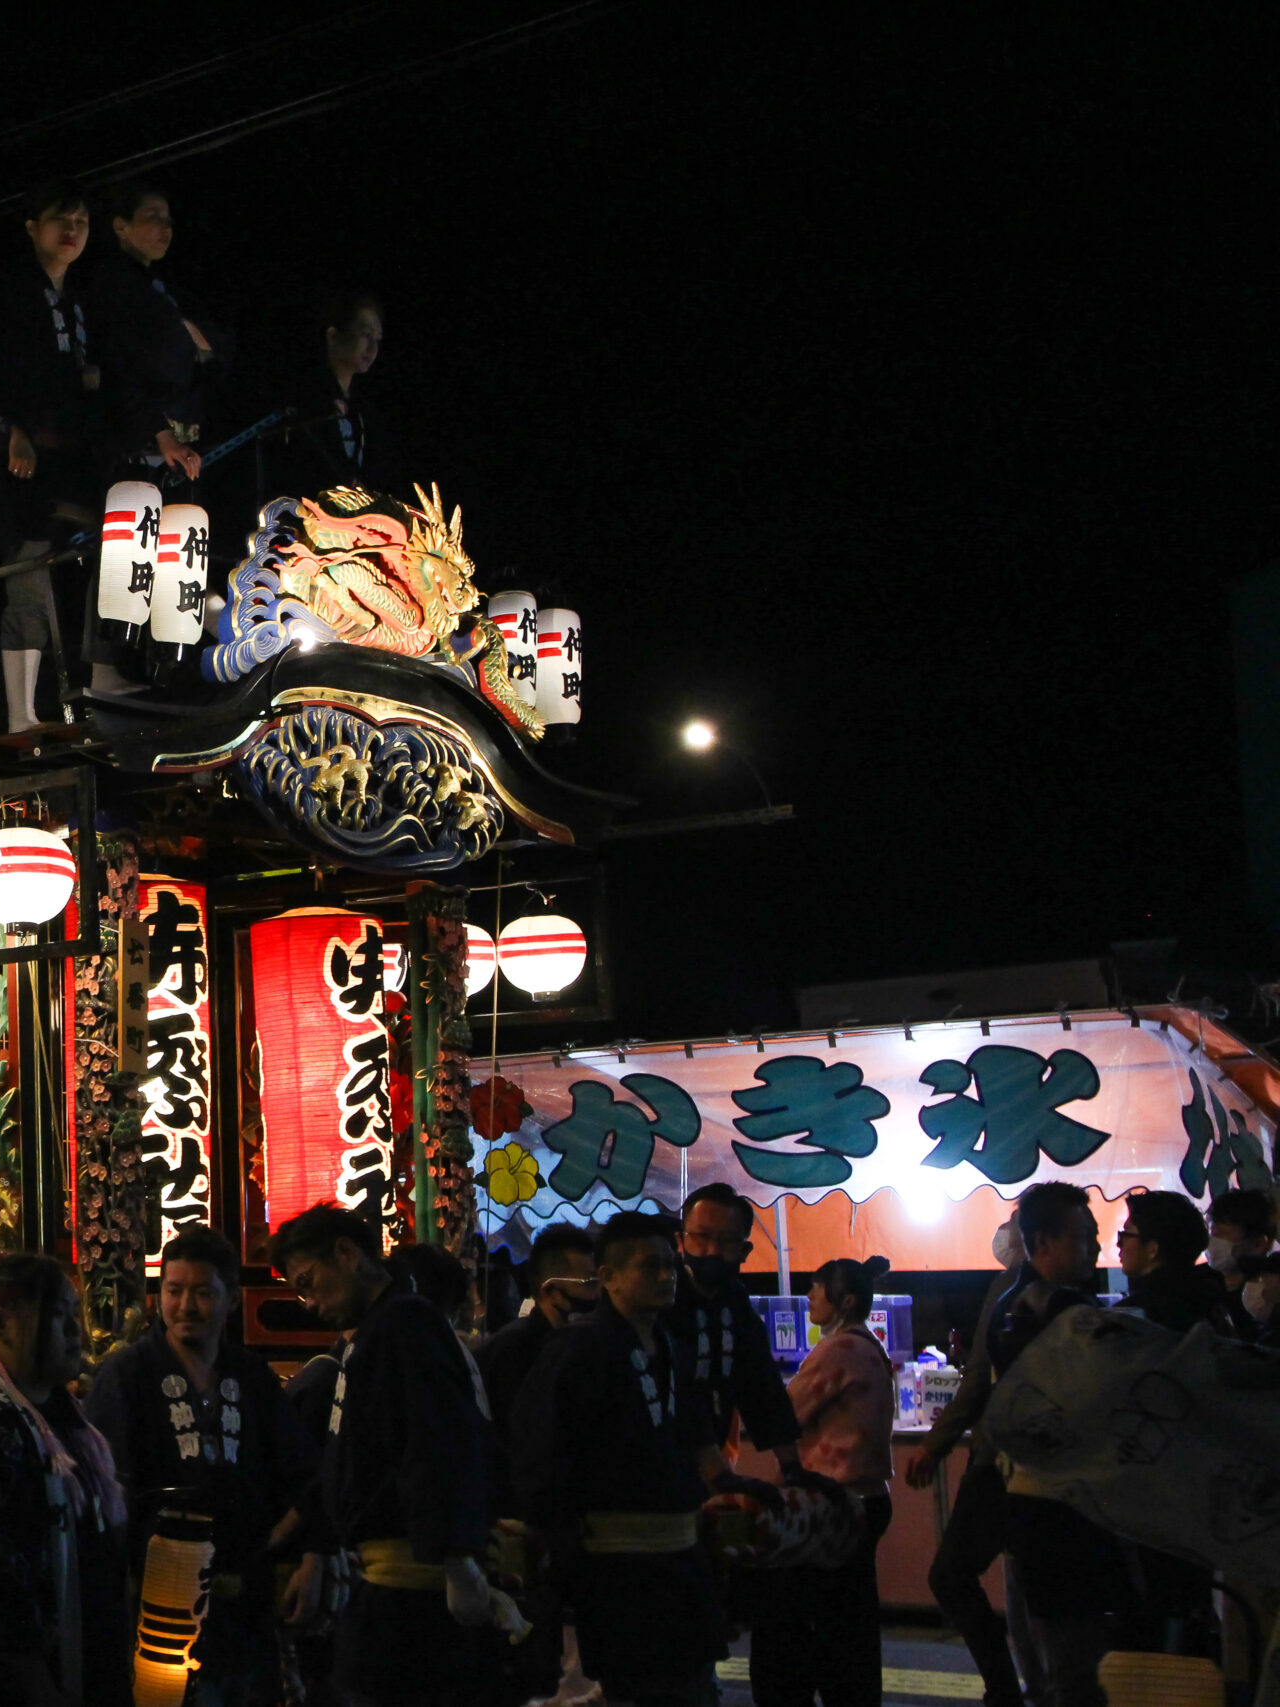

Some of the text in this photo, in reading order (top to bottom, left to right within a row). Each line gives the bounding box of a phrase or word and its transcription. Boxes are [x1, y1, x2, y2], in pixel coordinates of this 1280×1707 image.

[128, 505, 161, 608] 仲町
[176, 526, 208, 625] 仲町
[542, 1045, 1111, 1201] かき氷
